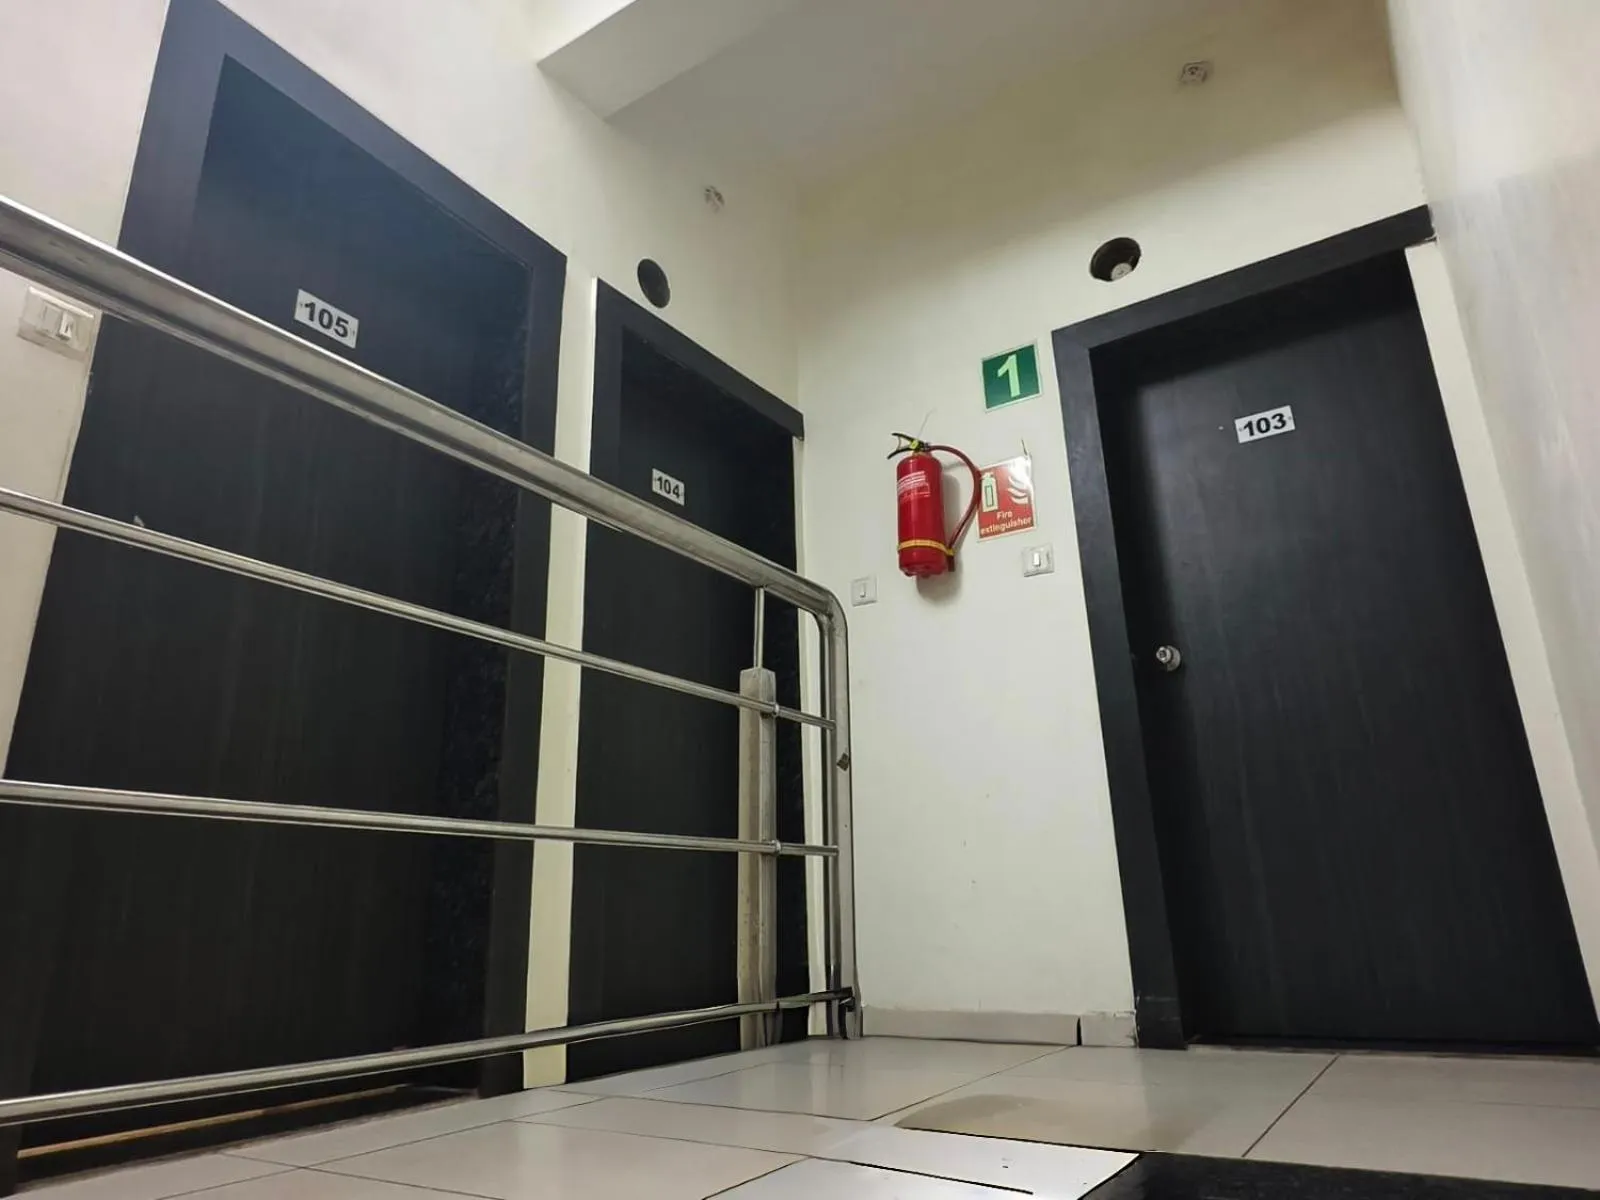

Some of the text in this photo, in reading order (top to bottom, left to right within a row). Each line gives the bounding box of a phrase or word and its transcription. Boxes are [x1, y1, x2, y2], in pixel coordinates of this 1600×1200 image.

[304, 302, 349, 338] 105
[997, 353, 1020, 398] 1
[1243, 413, 1287, 437] 103
[657, 476, 680, 499] 104
[980, 517, 1032, 535] extinguisher
[996, 511, 1013, 520] Fire
